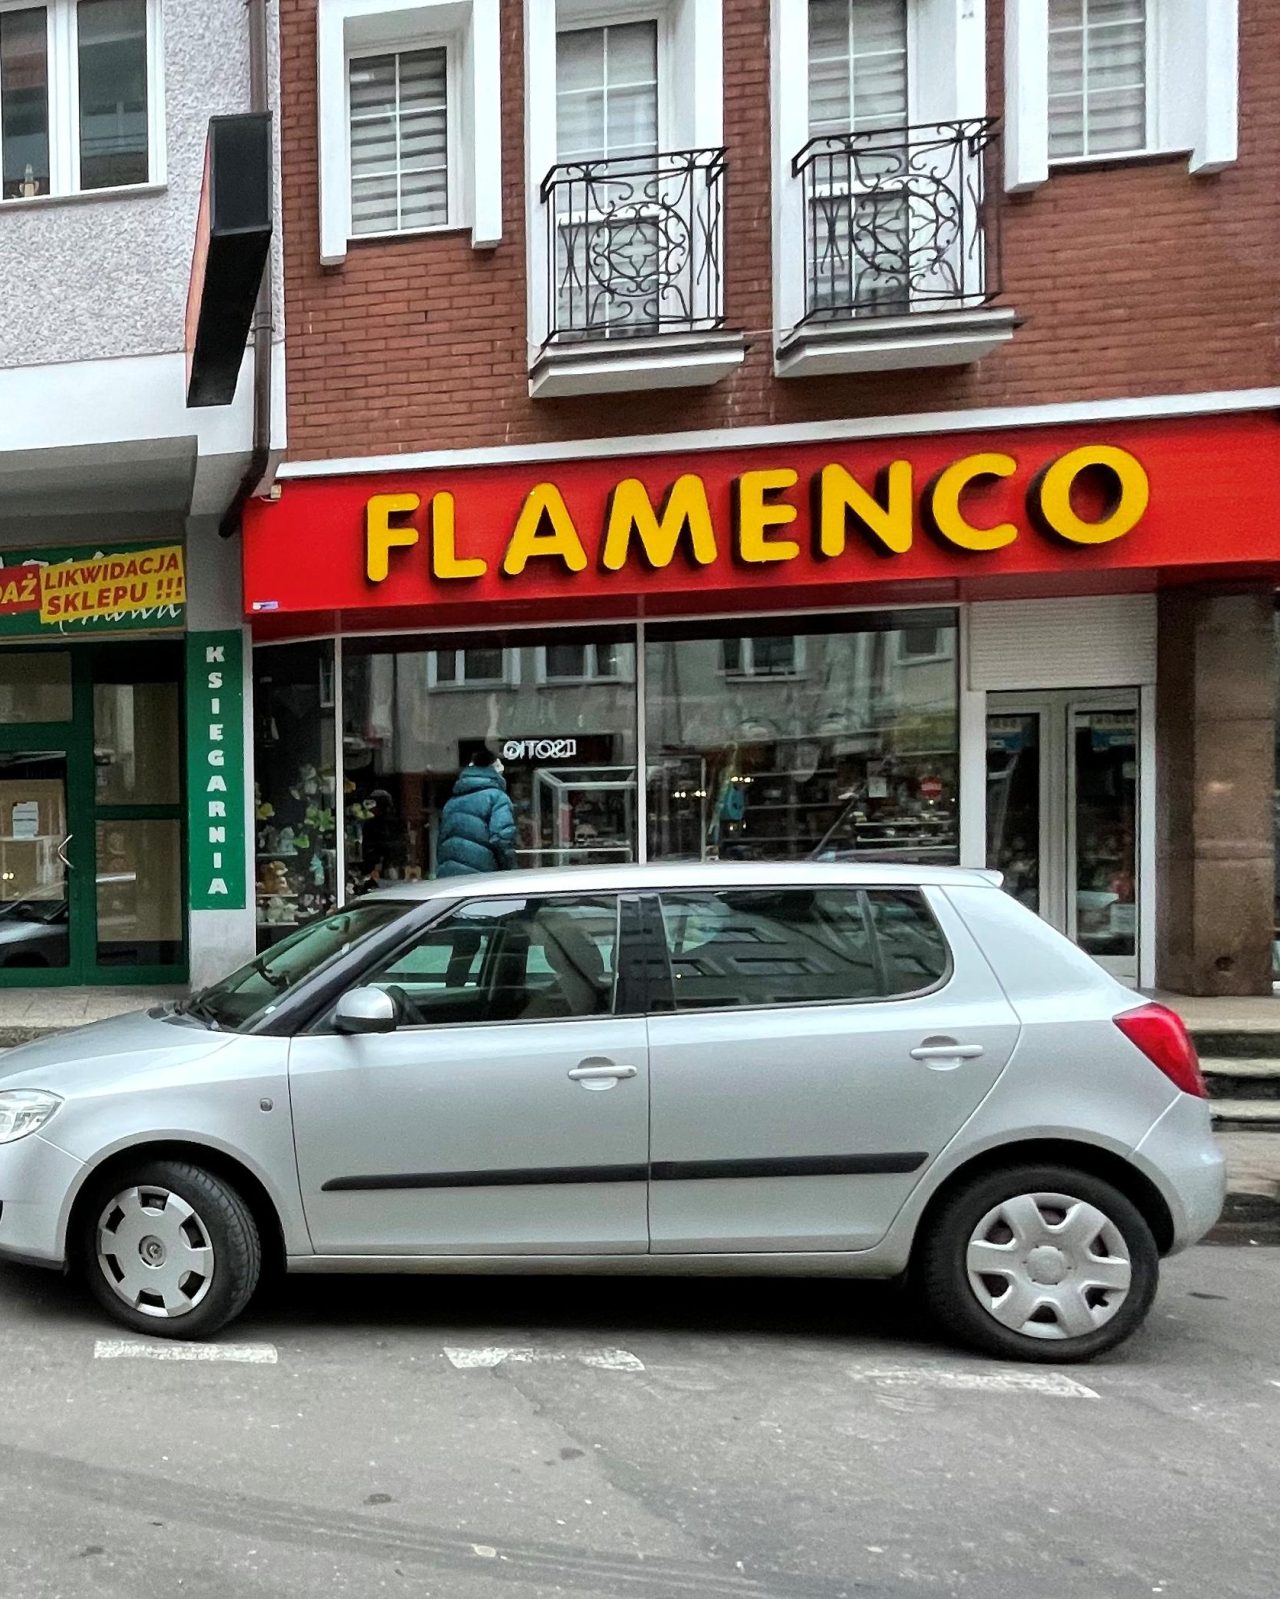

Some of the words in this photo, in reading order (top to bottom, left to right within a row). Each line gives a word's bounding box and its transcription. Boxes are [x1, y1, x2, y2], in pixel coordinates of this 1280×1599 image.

[365, 443, 1150, 582] FLAMENCO
[44, 552, 180, 590] LIKWIDACJA
[47, 582, 149, 616] SKLEPU
[156, 576, 184, 601] !!!
[206, 646, 228, 896] KSIĘGARNIA
